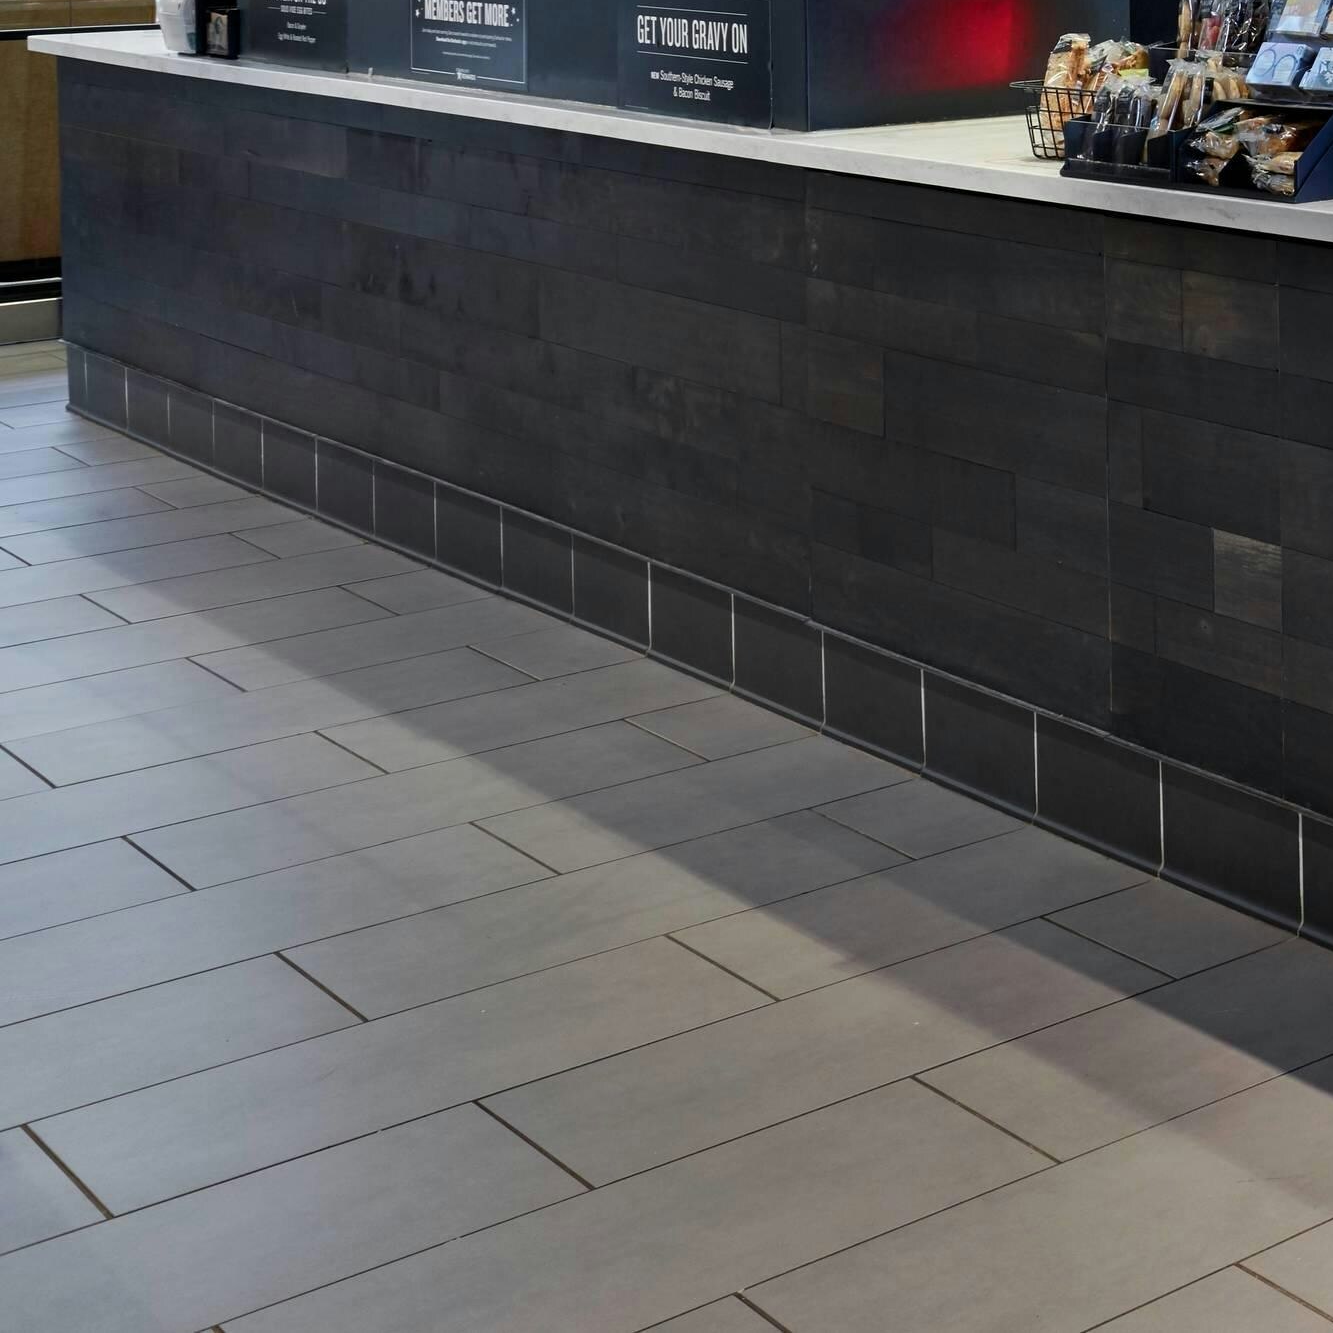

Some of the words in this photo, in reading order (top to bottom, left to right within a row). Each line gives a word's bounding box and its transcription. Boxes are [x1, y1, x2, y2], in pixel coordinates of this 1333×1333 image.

[466, 2, 483, 24] GET
[484, 3, 510, 27] MORE
[637, 15, 657, 44] GET
[660, 17, 689, 48] YOUR
[692, 20, 728, 52] GRAVY
[731, 23, 748, 54] ON
[650, 71, 660, 80] NEW
[660, 70, 693, 85] Southern-Style
[694, 74, 712, 86] Chicken
[714, 76, 734, 90] Sausage
